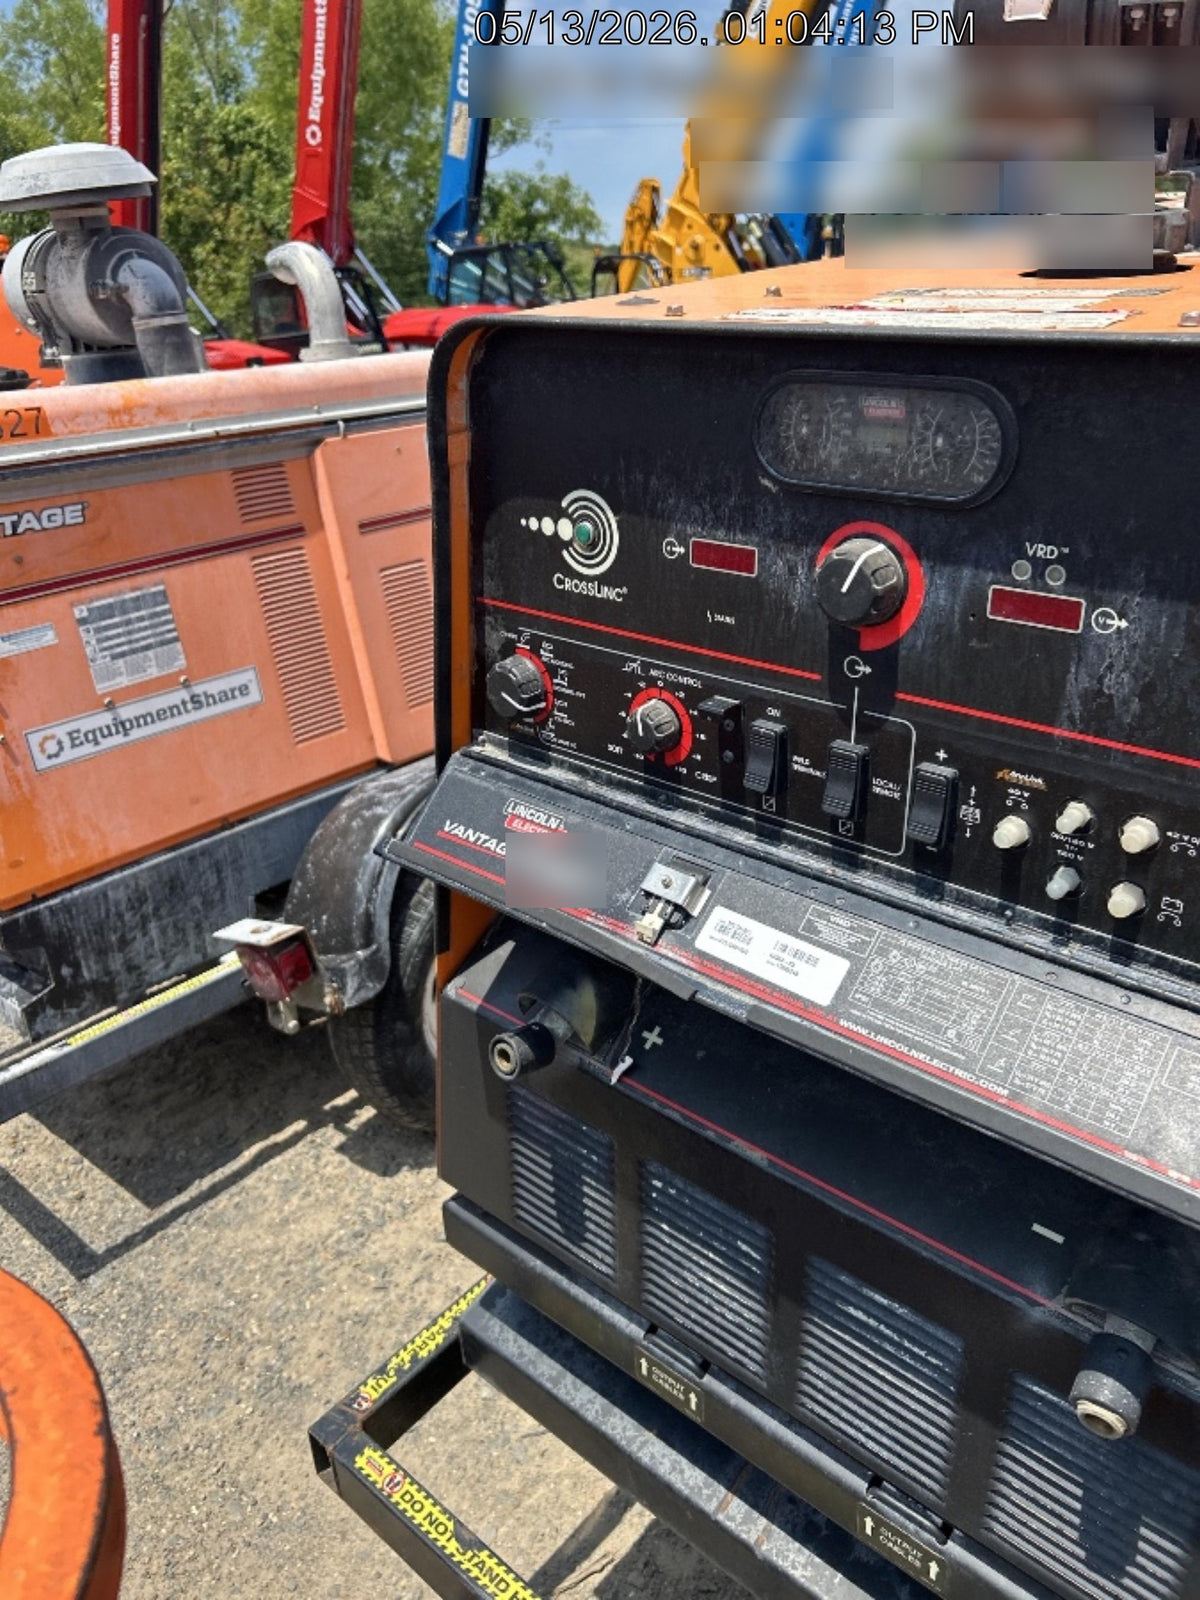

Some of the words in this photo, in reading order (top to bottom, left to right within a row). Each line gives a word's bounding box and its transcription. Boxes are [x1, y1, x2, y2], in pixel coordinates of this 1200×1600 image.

[1025, 541, 1059, 559] VRD
[666, 673, 703, 689] CONTROL
[66, 682, 252, 750] EquipmentShare
[766, 706, 781, 717] ON
[507, 801, 563, 829] LINCOLN
[839, 1018, 1009, 1096] WWW.LINCOLNELECTRIC.COM
[652, 1366, 685, 1393] OUTPUT
[652, 1373, 686, 1401] CABLES
[399, 1490, 425, 1514] DO
[879, 1535, 922, 1569] CABLES
[880, 1526, 923, 1559] OUTPUT
